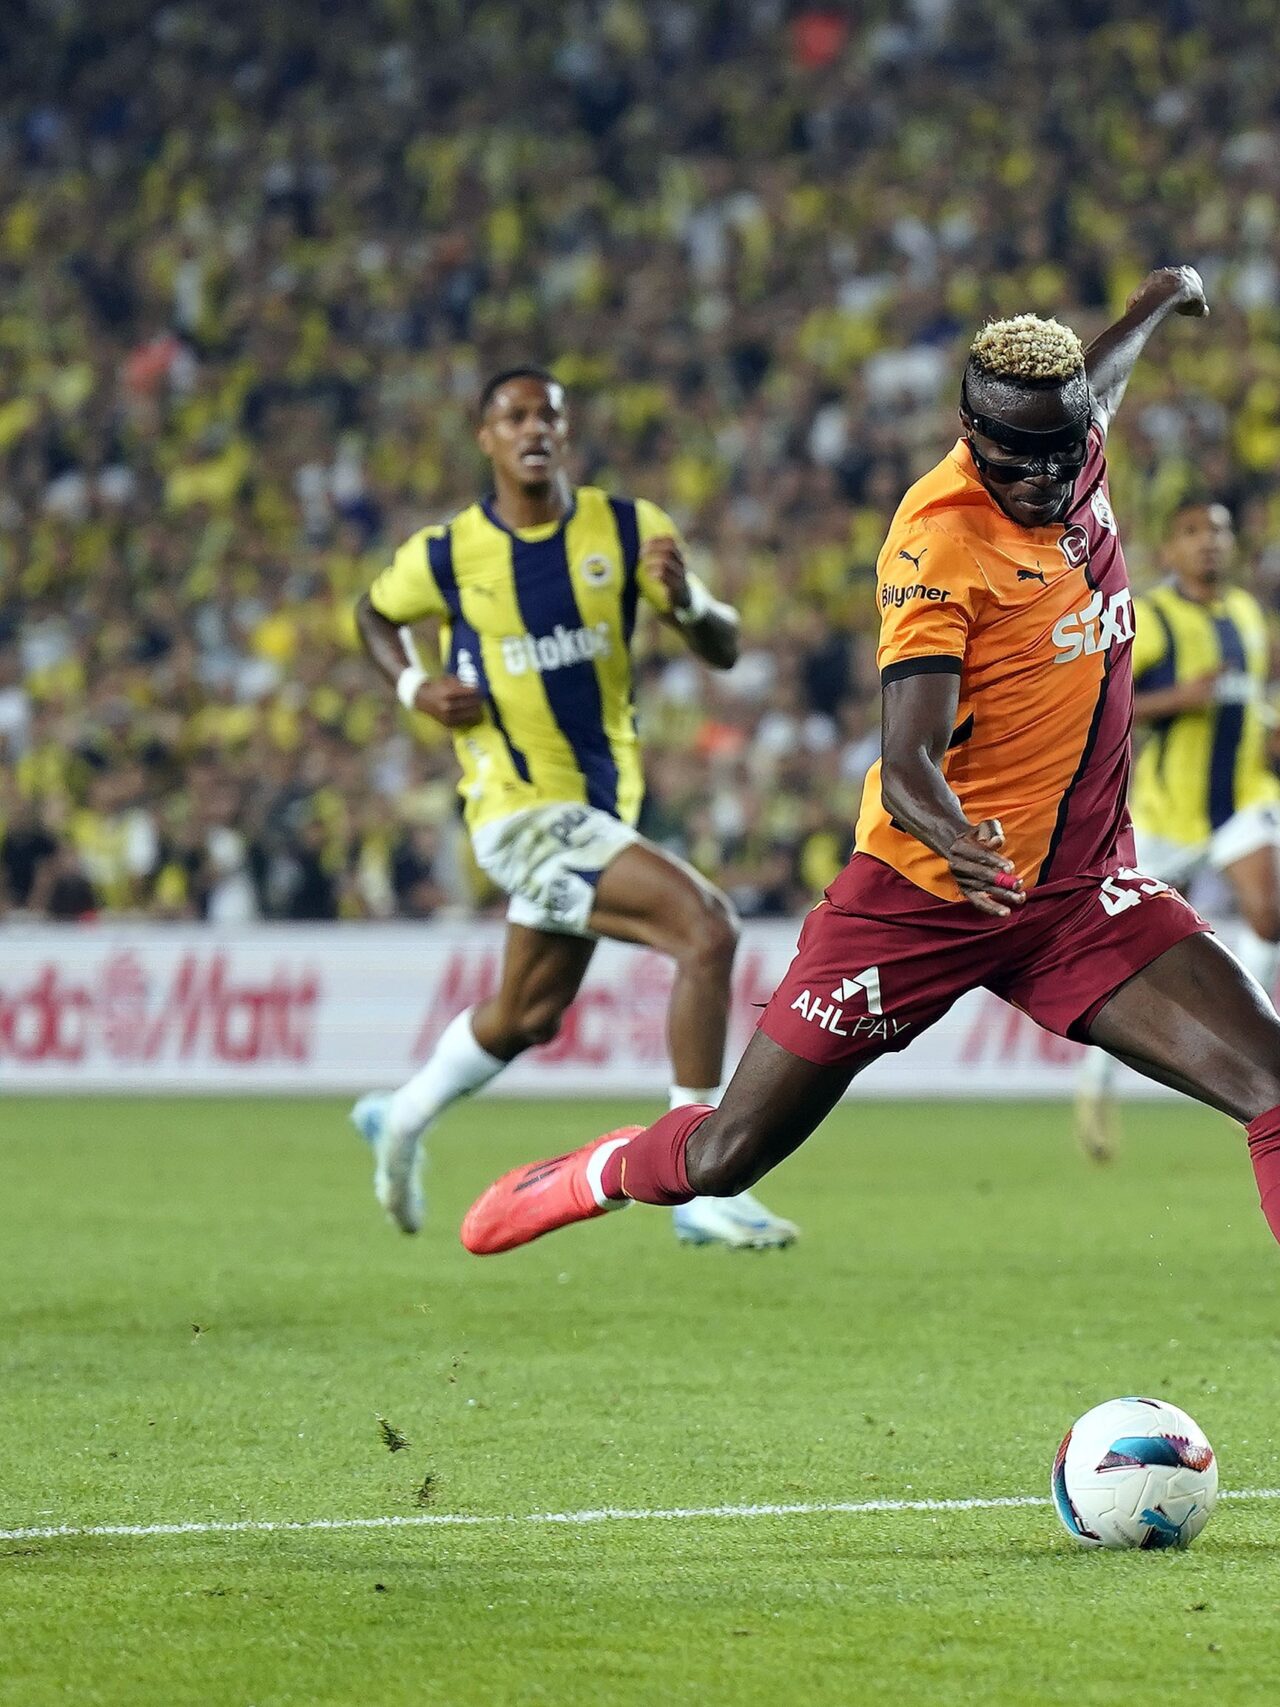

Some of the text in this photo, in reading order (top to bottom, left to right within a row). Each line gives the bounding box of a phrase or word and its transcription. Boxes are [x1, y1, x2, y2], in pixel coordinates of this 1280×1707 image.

[882, 583, 951, 608] Bilyoner
[790, 989, 911, 1040] AHL PAY
